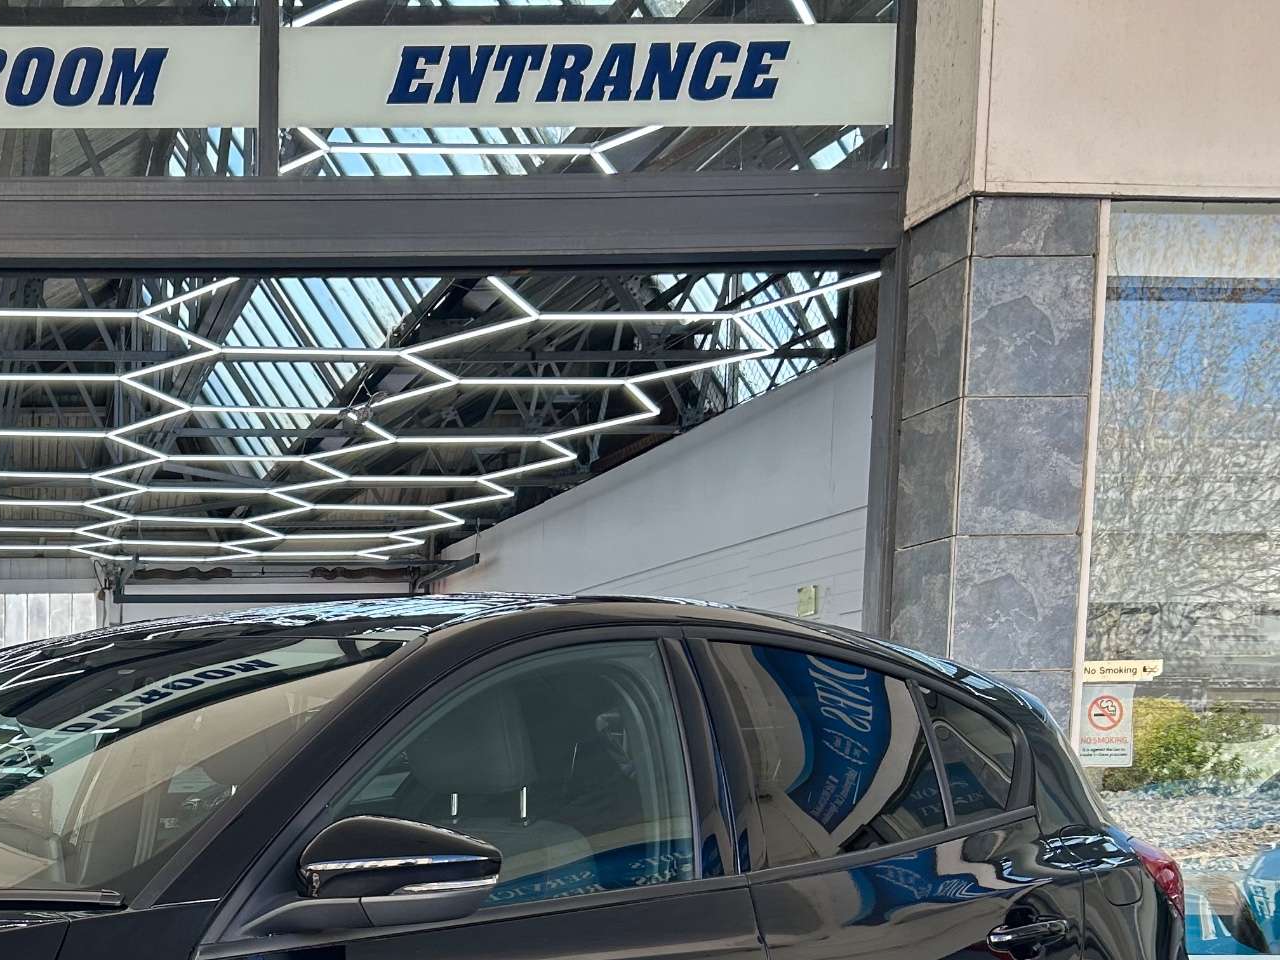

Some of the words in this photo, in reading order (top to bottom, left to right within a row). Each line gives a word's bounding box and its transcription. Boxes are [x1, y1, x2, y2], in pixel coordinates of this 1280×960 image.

[386, 41, 791, 104] ENTRANCE
[1083, 667, 1096, 675] No
[1099, 666, 1138, 676] Smoking
